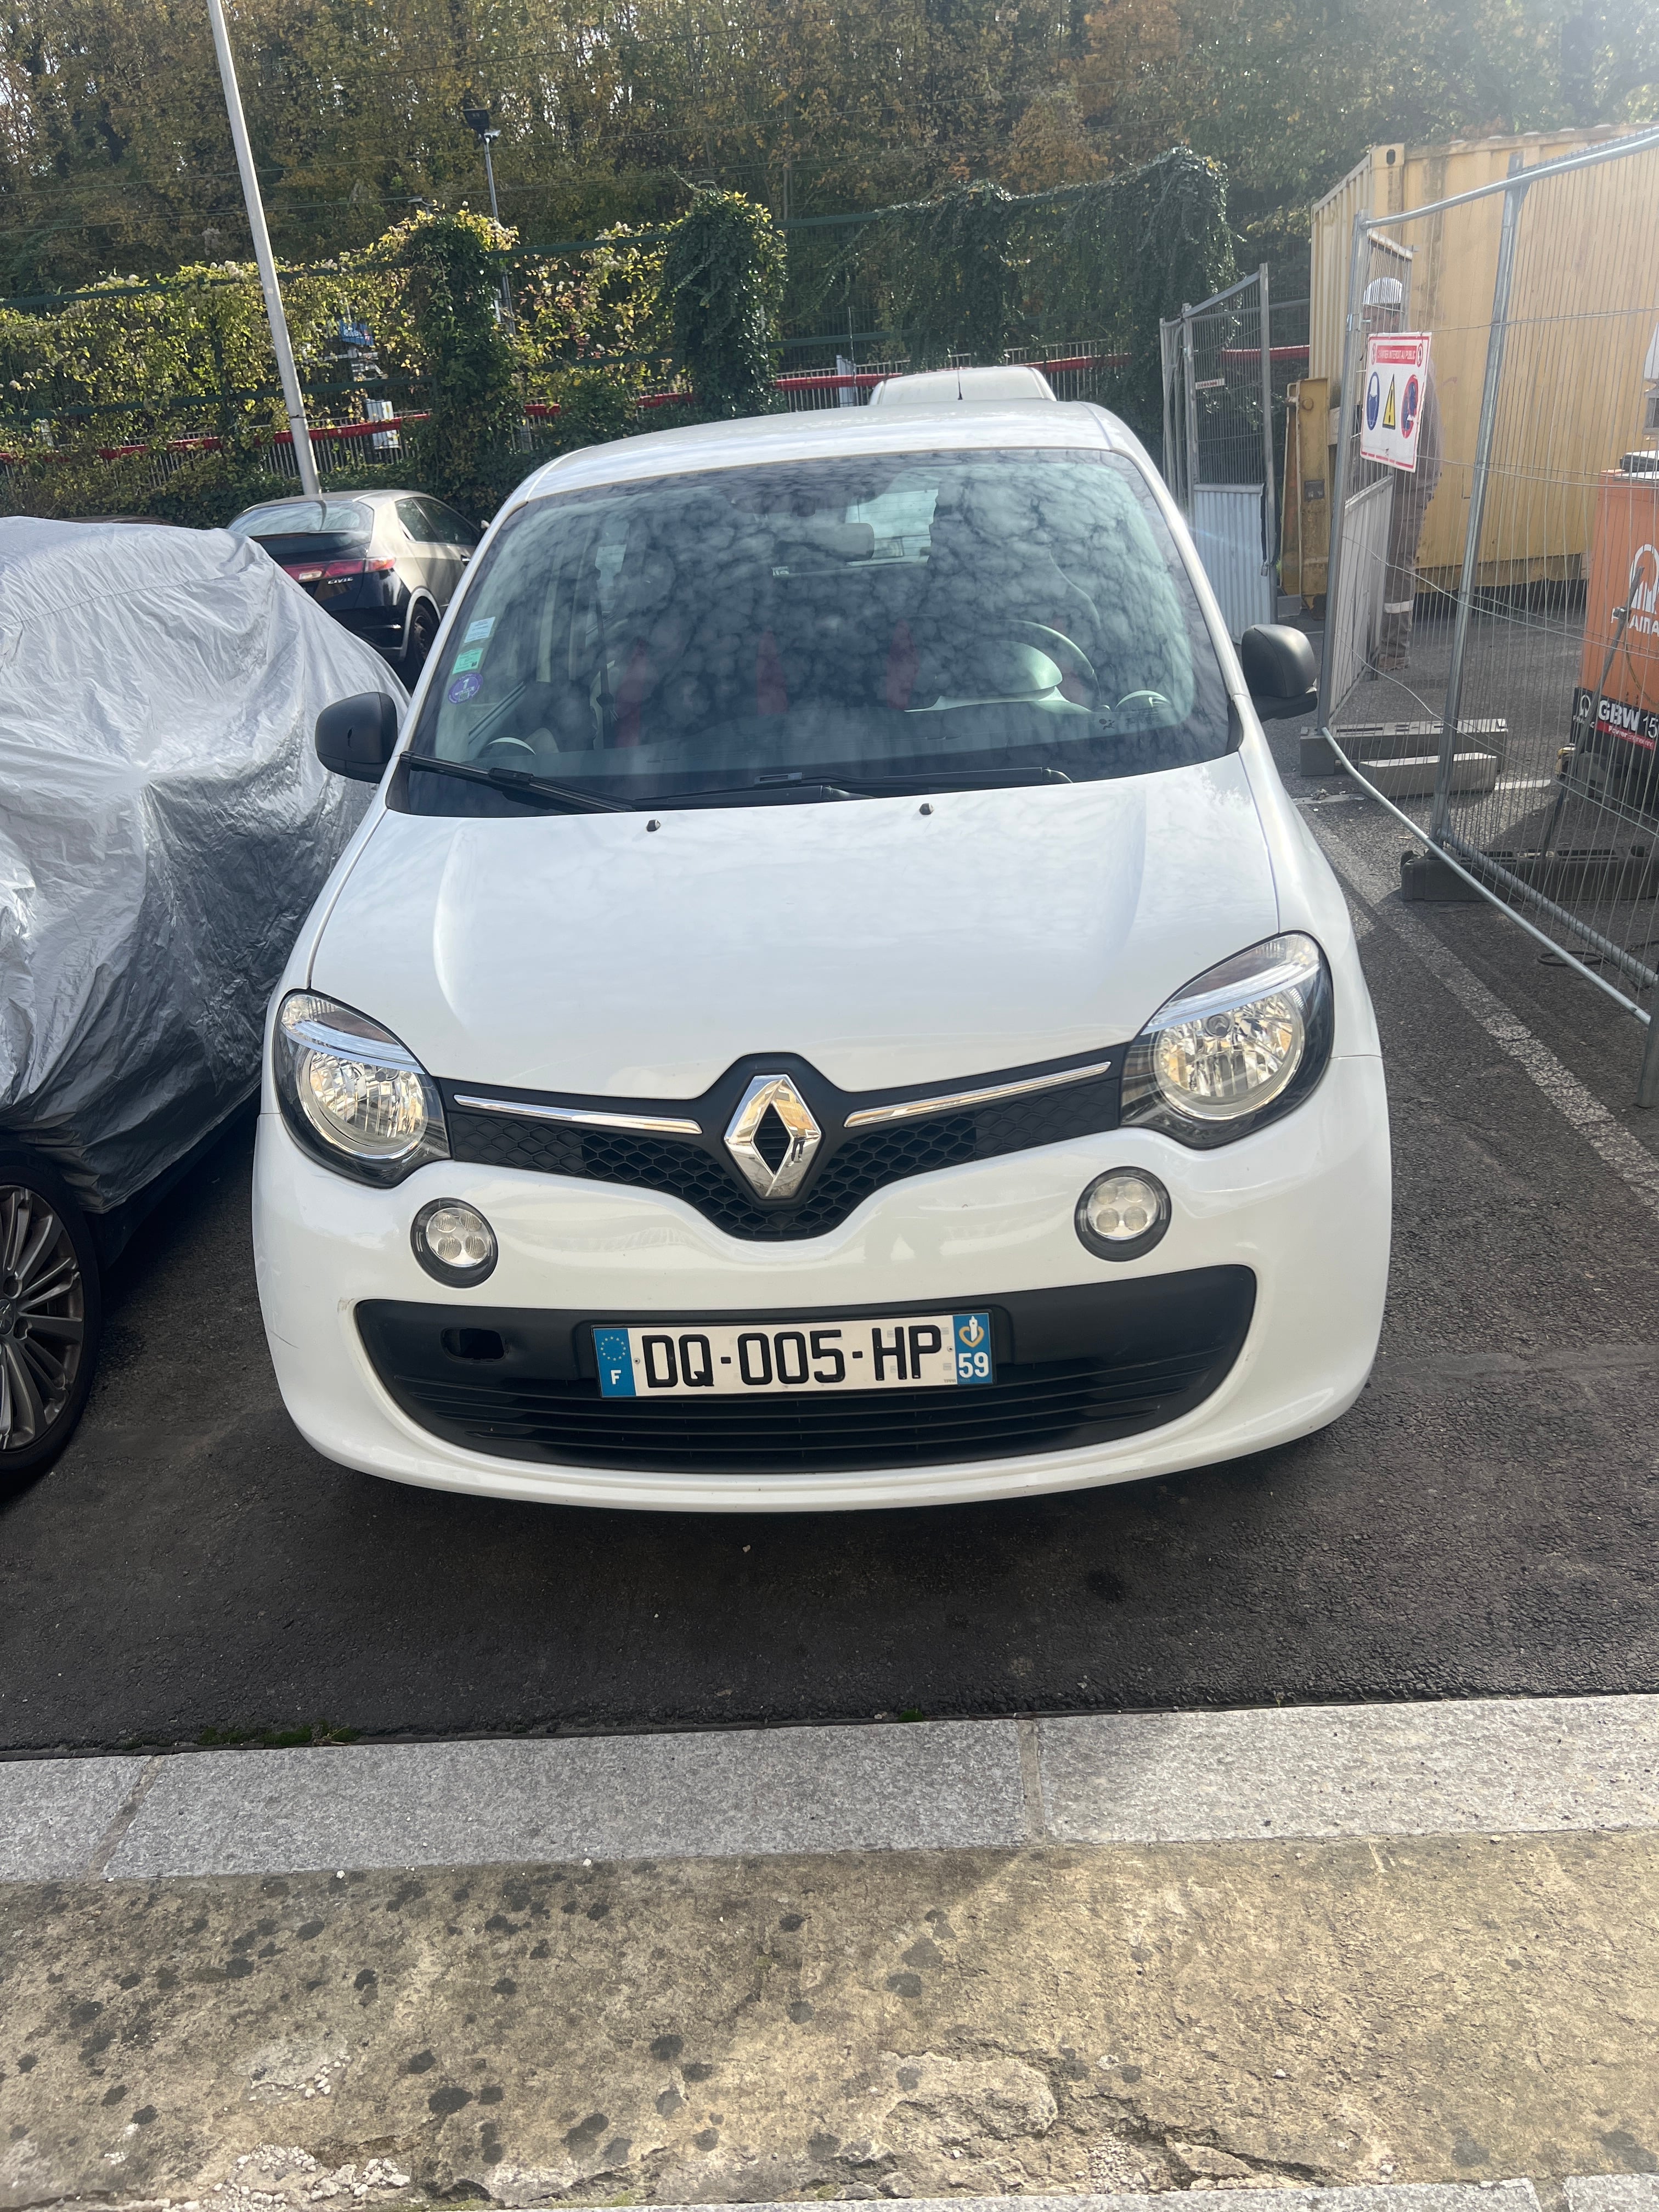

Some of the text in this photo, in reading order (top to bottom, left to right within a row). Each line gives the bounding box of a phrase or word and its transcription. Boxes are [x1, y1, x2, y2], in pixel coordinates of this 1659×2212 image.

[463, 678, 470, 690] 1
[1598, 699, 1641, 731] GBW
[642, 1325, 941, 1388] DQ-005-HP
[958, 1351, 989, 1378] 59
[611, 1369, 622, 1385] F
